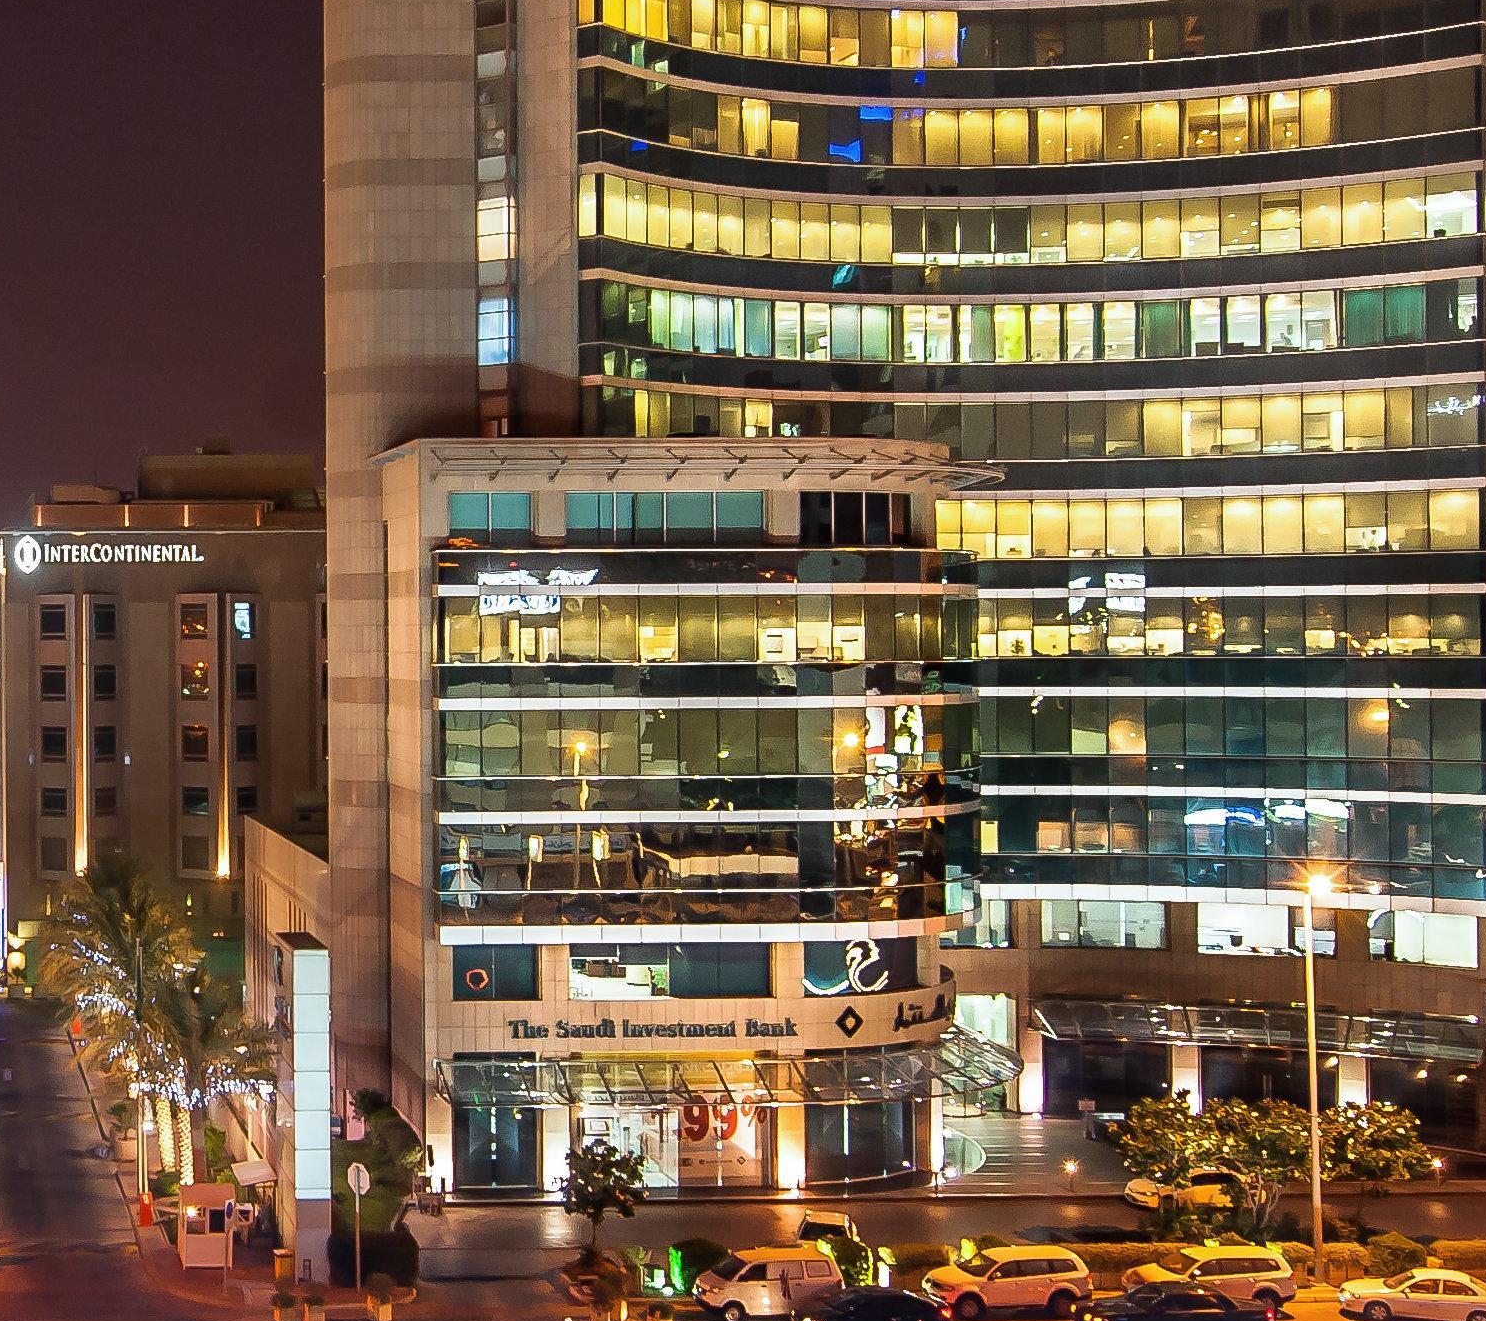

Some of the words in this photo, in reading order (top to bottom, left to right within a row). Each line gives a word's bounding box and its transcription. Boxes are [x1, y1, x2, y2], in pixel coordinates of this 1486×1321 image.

[507, 1018, 550, 1039] The
[555, 1018, 617, 1039] Saudi
[622, 1018, 737, 1039] Investment
[744, 1017, 799, 1038] Bank
